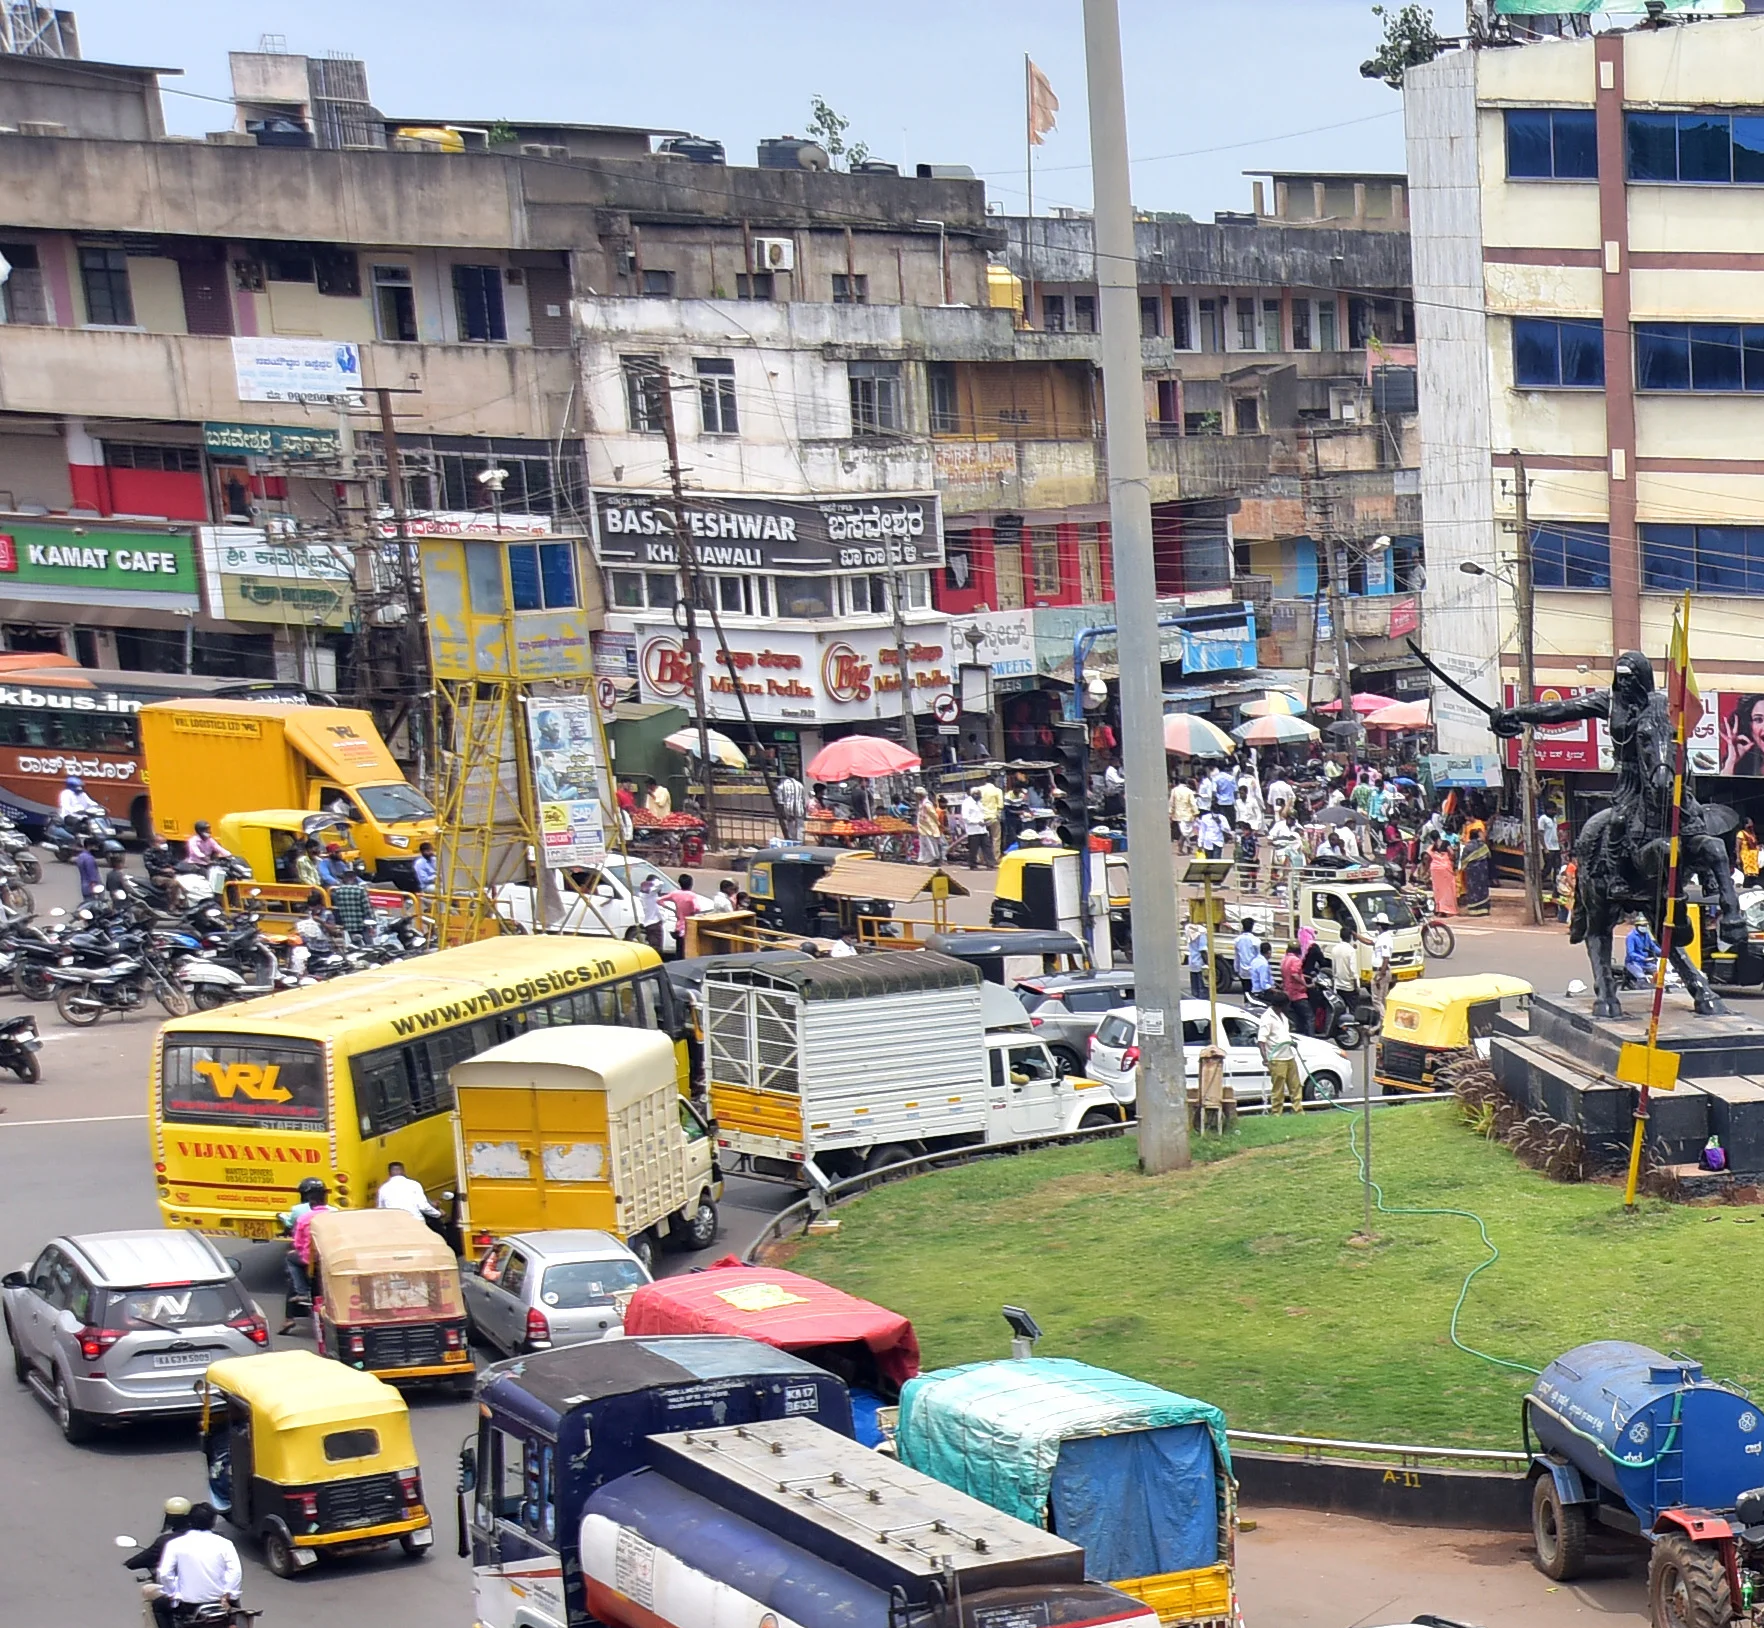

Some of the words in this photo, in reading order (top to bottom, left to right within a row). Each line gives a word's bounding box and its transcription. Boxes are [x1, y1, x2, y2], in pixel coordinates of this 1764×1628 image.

[28, 543, 109, 571] KAMAT
[116, 550, 180, 575] CAFE
[767, 678, 815, 699] Pedha
[192, 1060, 293, 1104] VRL
[259, 1118, 299, 1131] STAFF
[301, 1120, 326, 1133] BUS
[177, 1140, 321, 1165] VIJAYANAND
